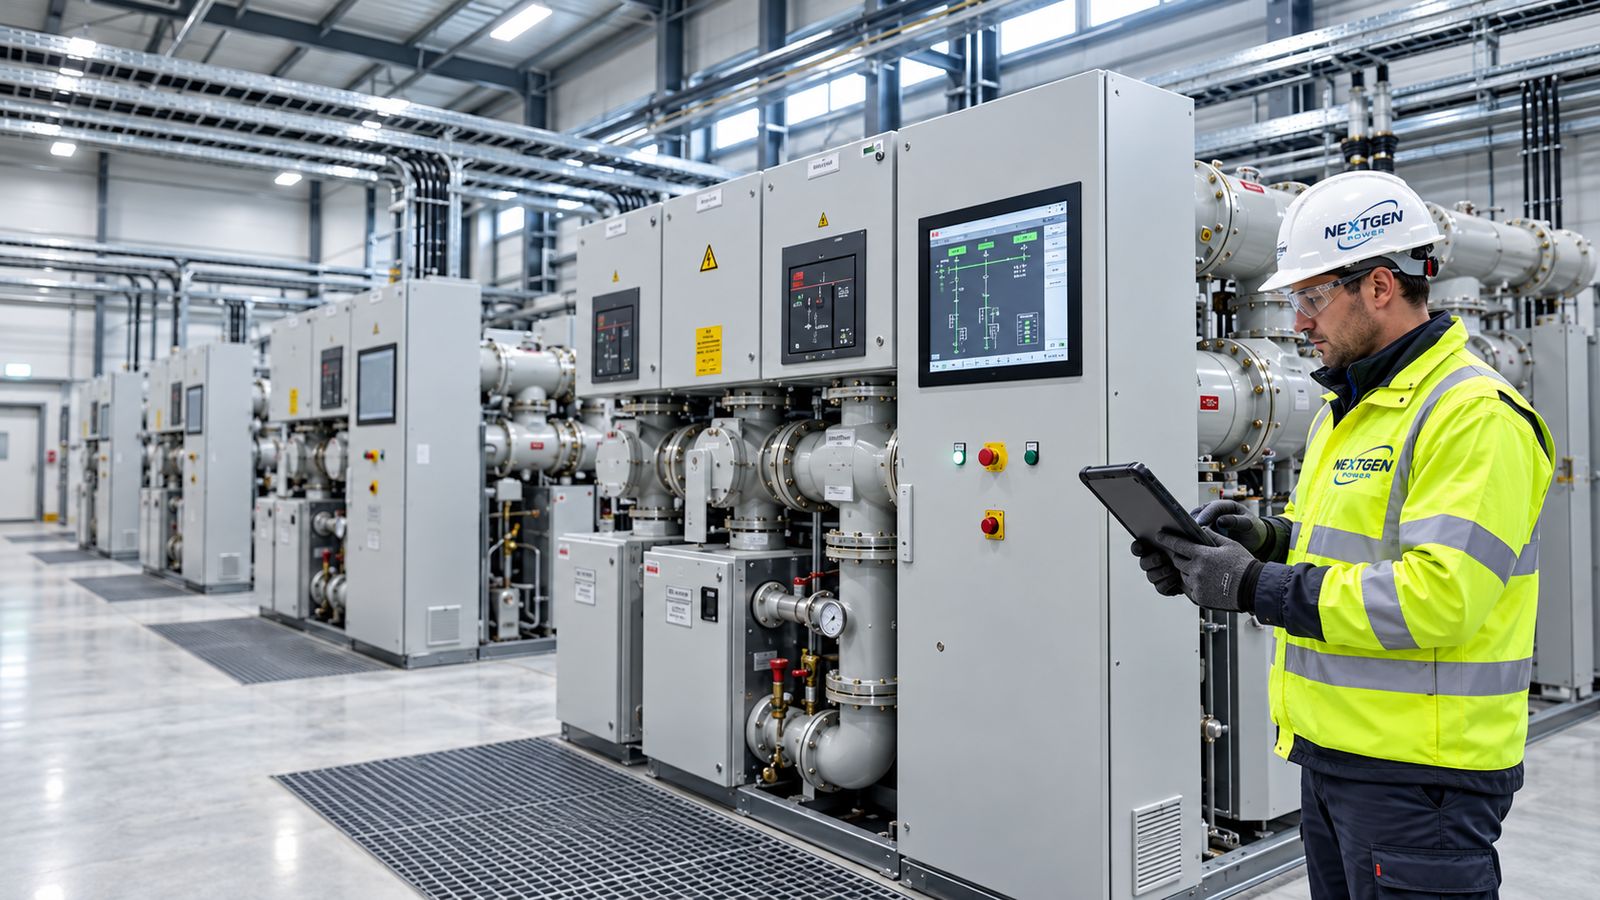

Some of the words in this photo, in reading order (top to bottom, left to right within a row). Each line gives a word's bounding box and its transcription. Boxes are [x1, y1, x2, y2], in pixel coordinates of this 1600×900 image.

[1324, 210, 1404, 239] NEXTGEN
[1347, 228, 1385, 241] POWER
[1333, 459, 1394, 472] NEXTGEN
